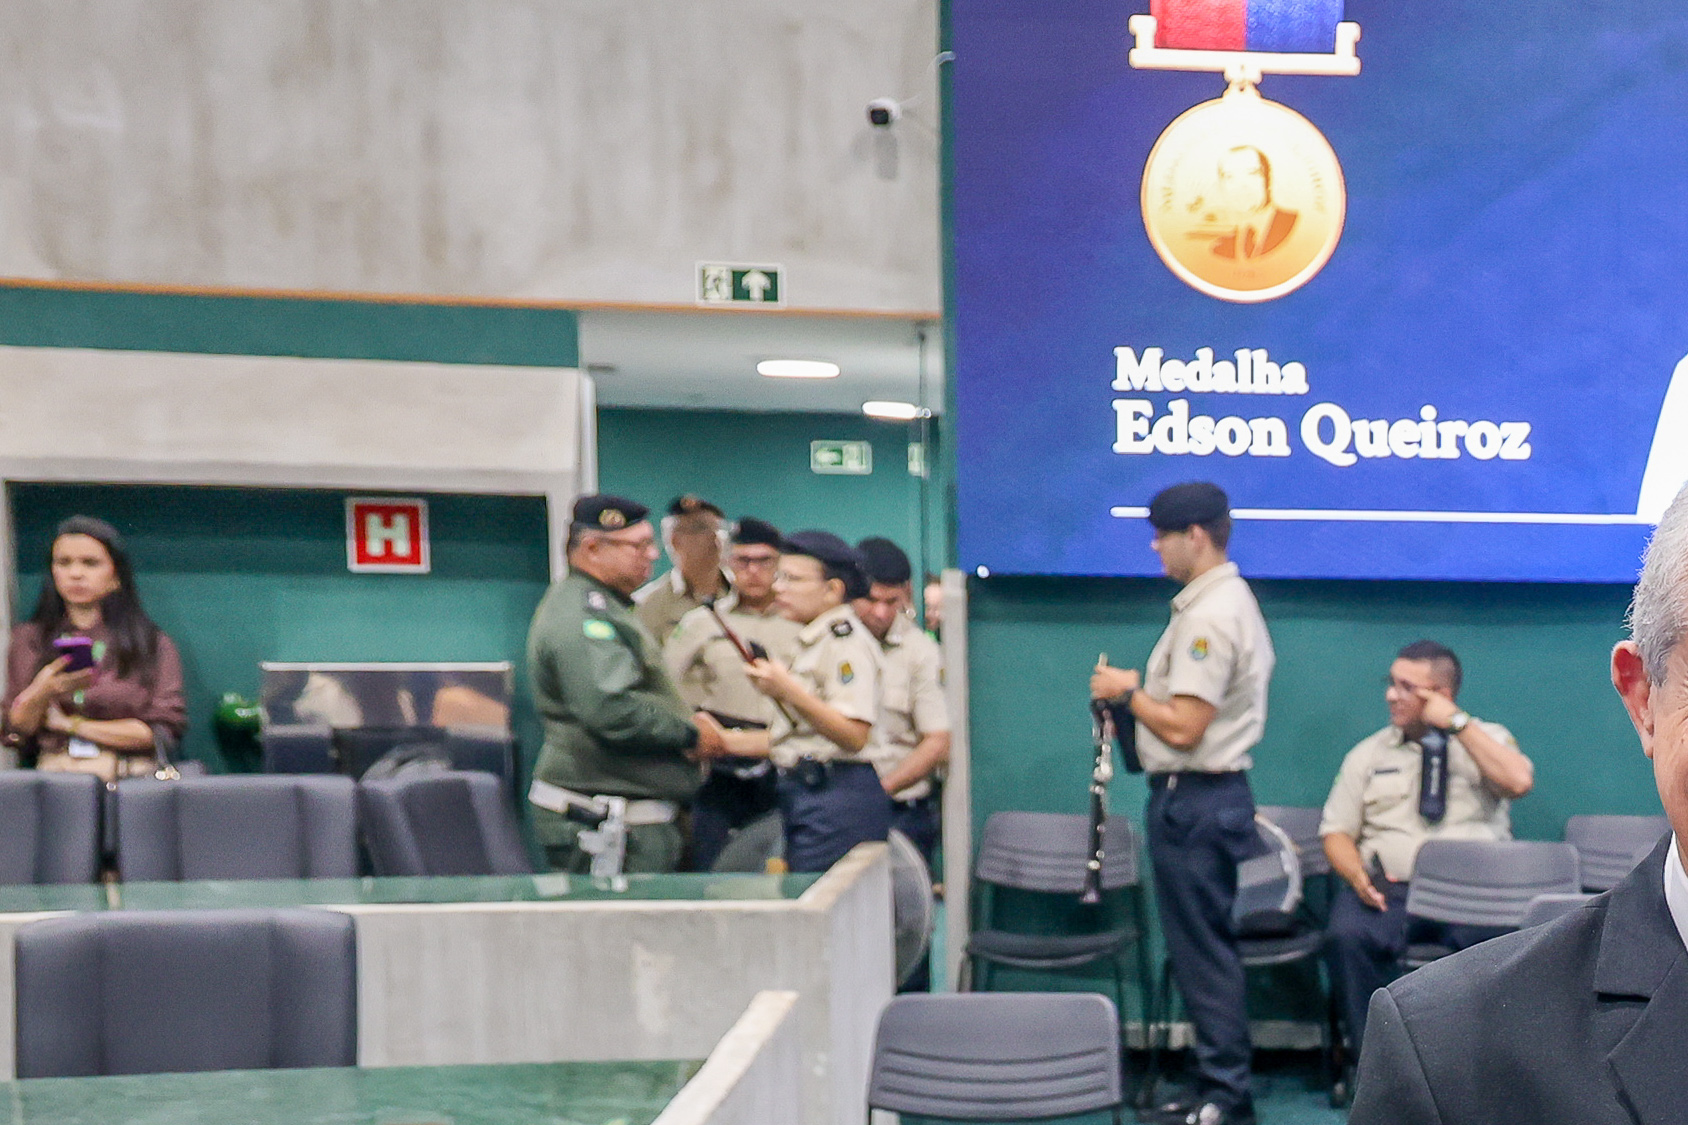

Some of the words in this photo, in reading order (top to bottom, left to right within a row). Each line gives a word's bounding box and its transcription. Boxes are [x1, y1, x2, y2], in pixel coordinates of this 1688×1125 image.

[1111, 346, 1310, 394] Medalha
[1111, 398, 1292, 457] Edson
[1300, 402, 1532, 467] Queiroz
[365, 512, 411, 557] H
